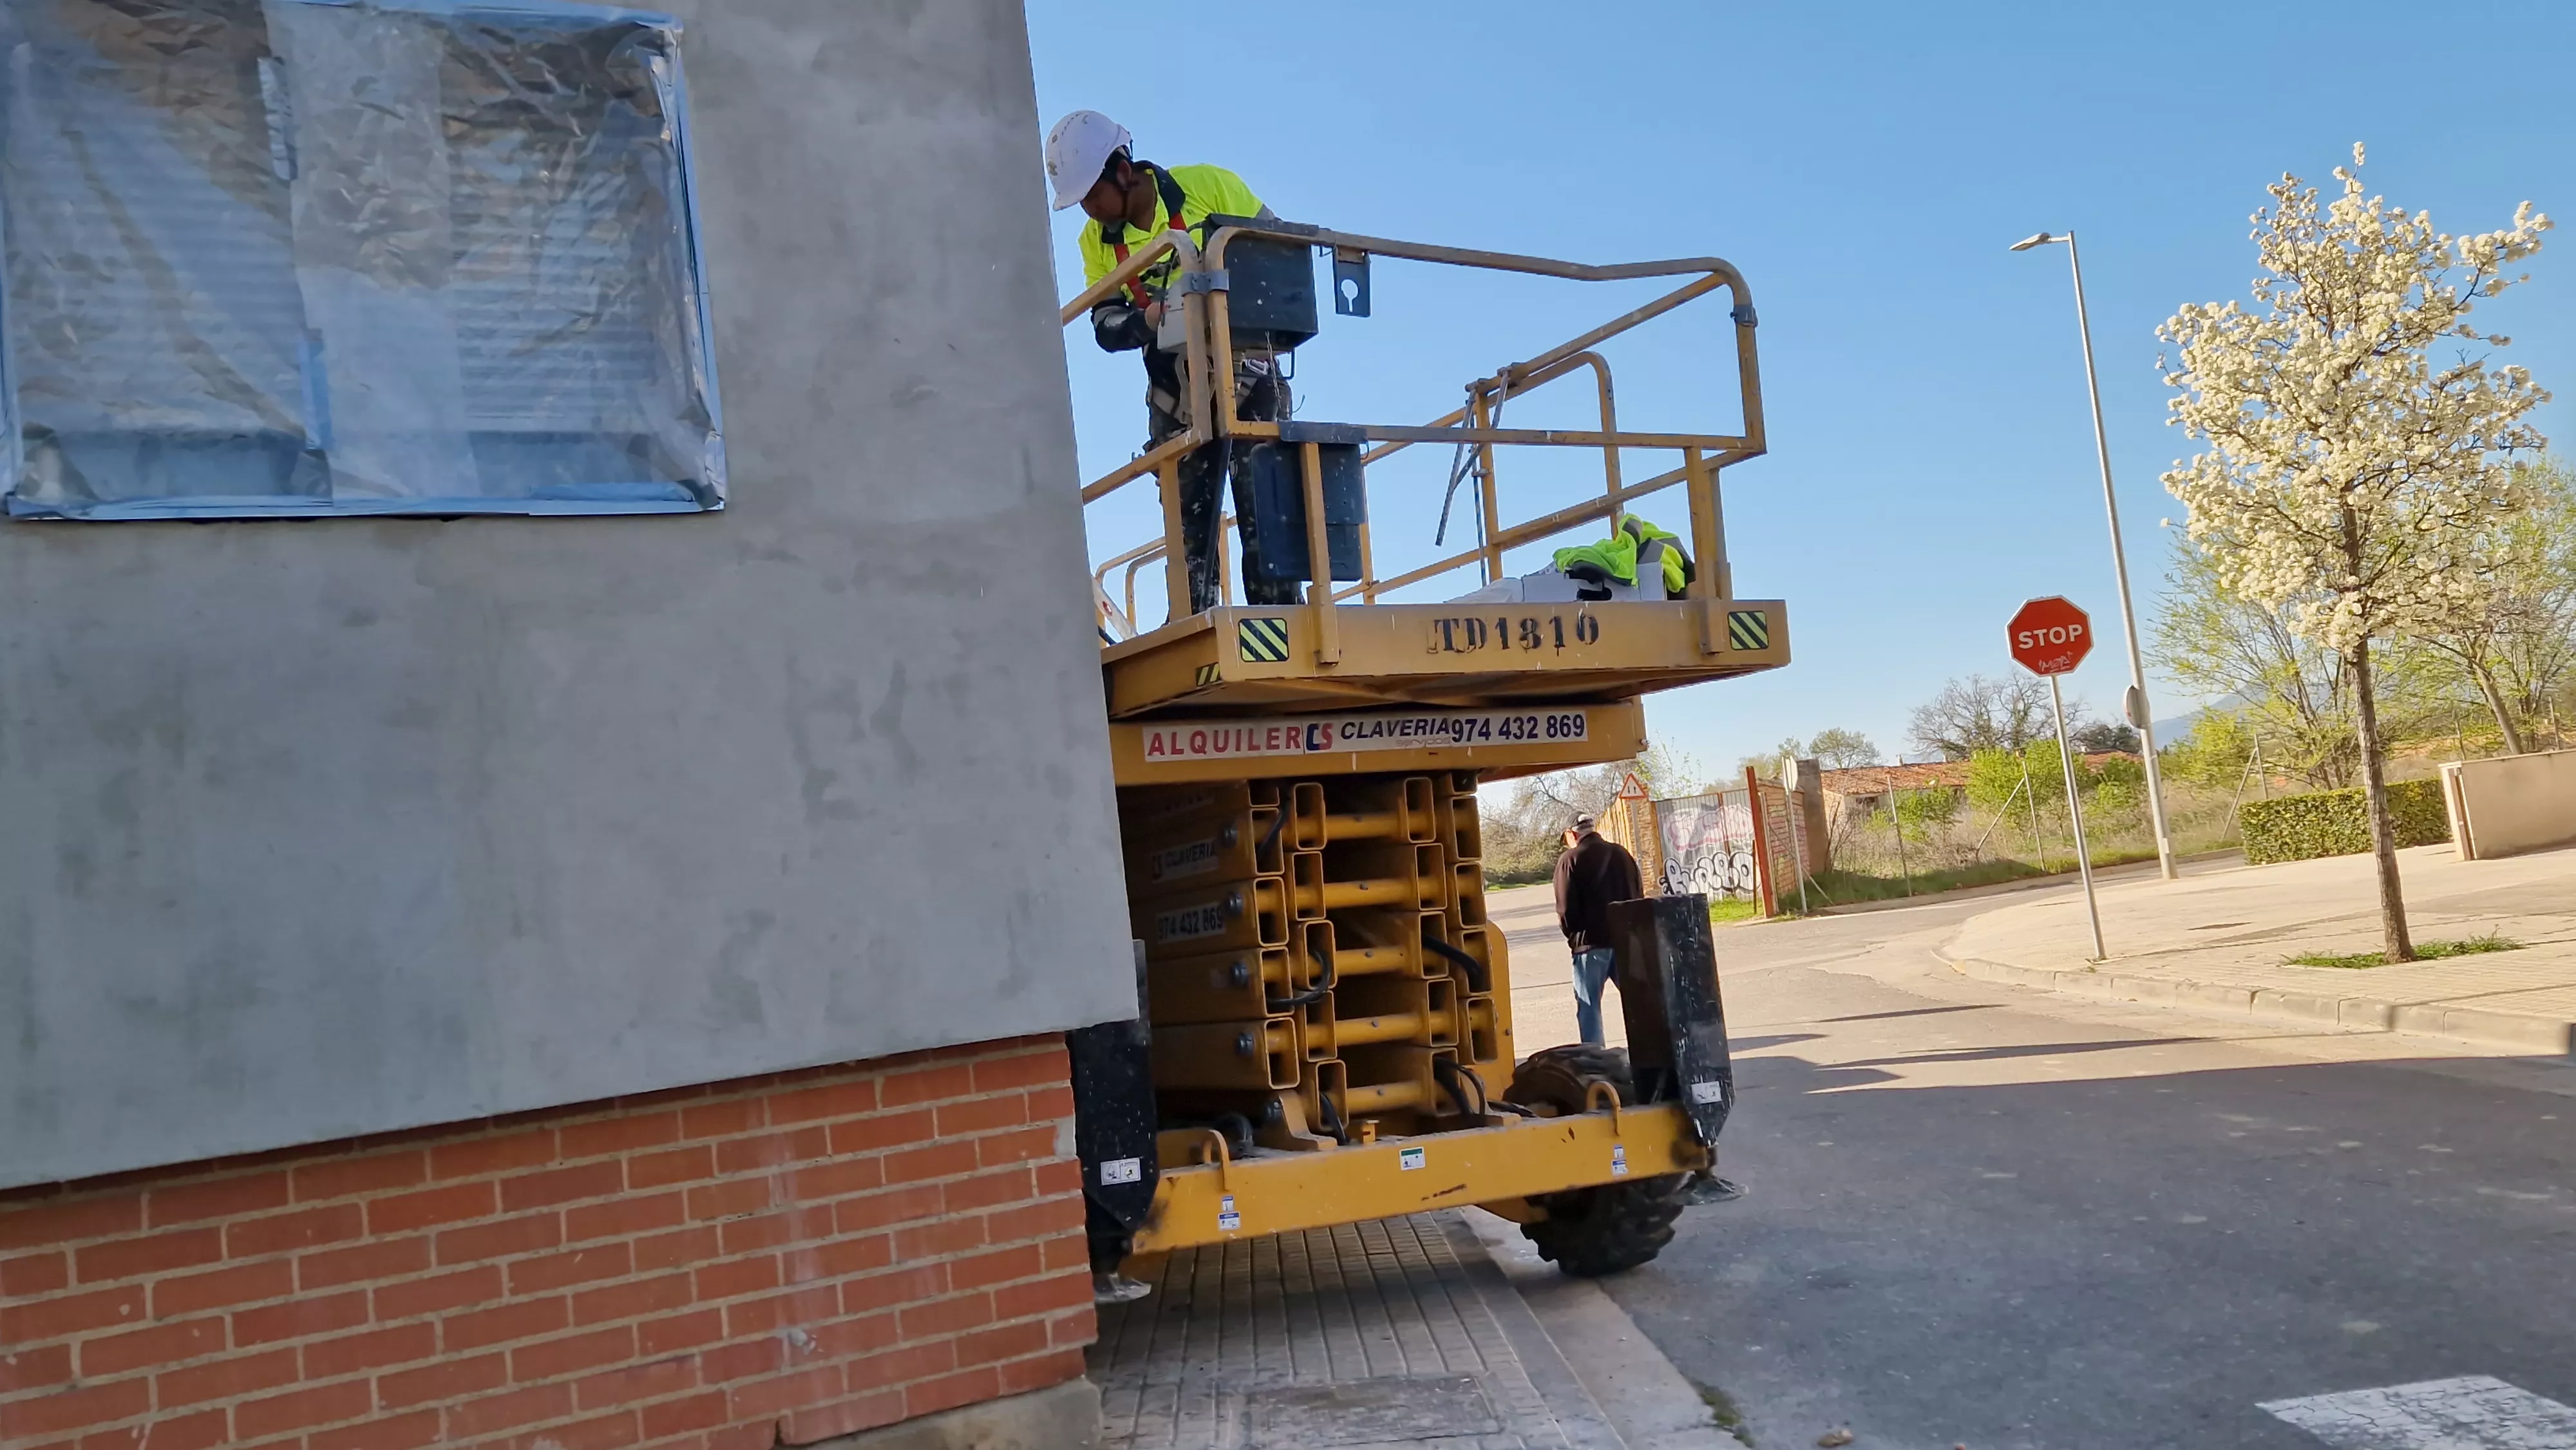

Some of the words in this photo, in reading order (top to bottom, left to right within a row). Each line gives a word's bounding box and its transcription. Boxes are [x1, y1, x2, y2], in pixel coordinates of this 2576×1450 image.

[2018, 624, 2083, 650] STOP
[1147, 726, 1302, 757] ALQUILER
[1340, 717, 1450, 740] CLAVERIA
[1452, 717, 1492, 743] 974
[1498, 715, 1539, 740] 432
[1546, 713, 1585, 739] 869
